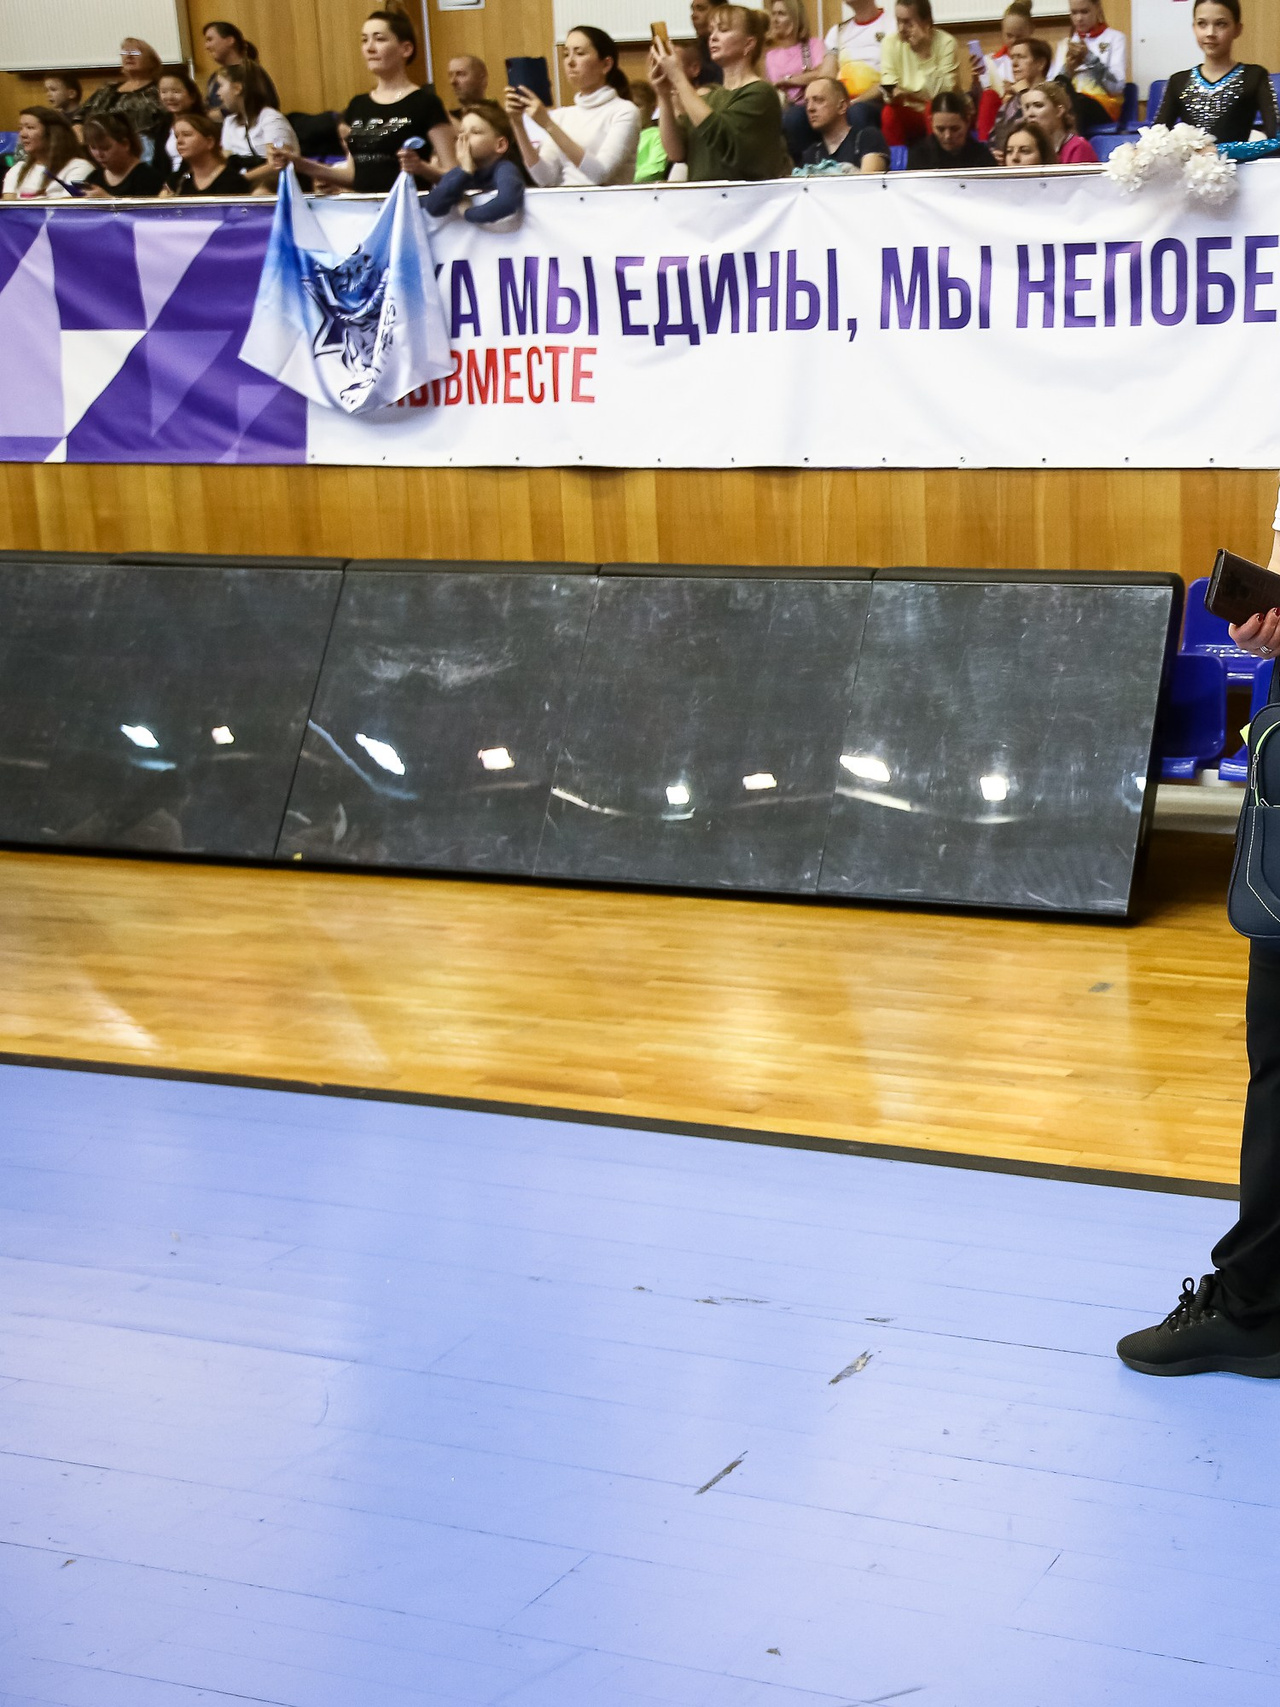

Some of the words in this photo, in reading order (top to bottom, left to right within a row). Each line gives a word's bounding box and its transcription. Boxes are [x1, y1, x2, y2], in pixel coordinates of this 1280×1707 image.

[433, 259, 482, 338] А
[499, 256, 599, 336] МЫ
[615, 248, 858, 346] ЕДИНЫ,
[880, 245, 992, 330] МЫ
